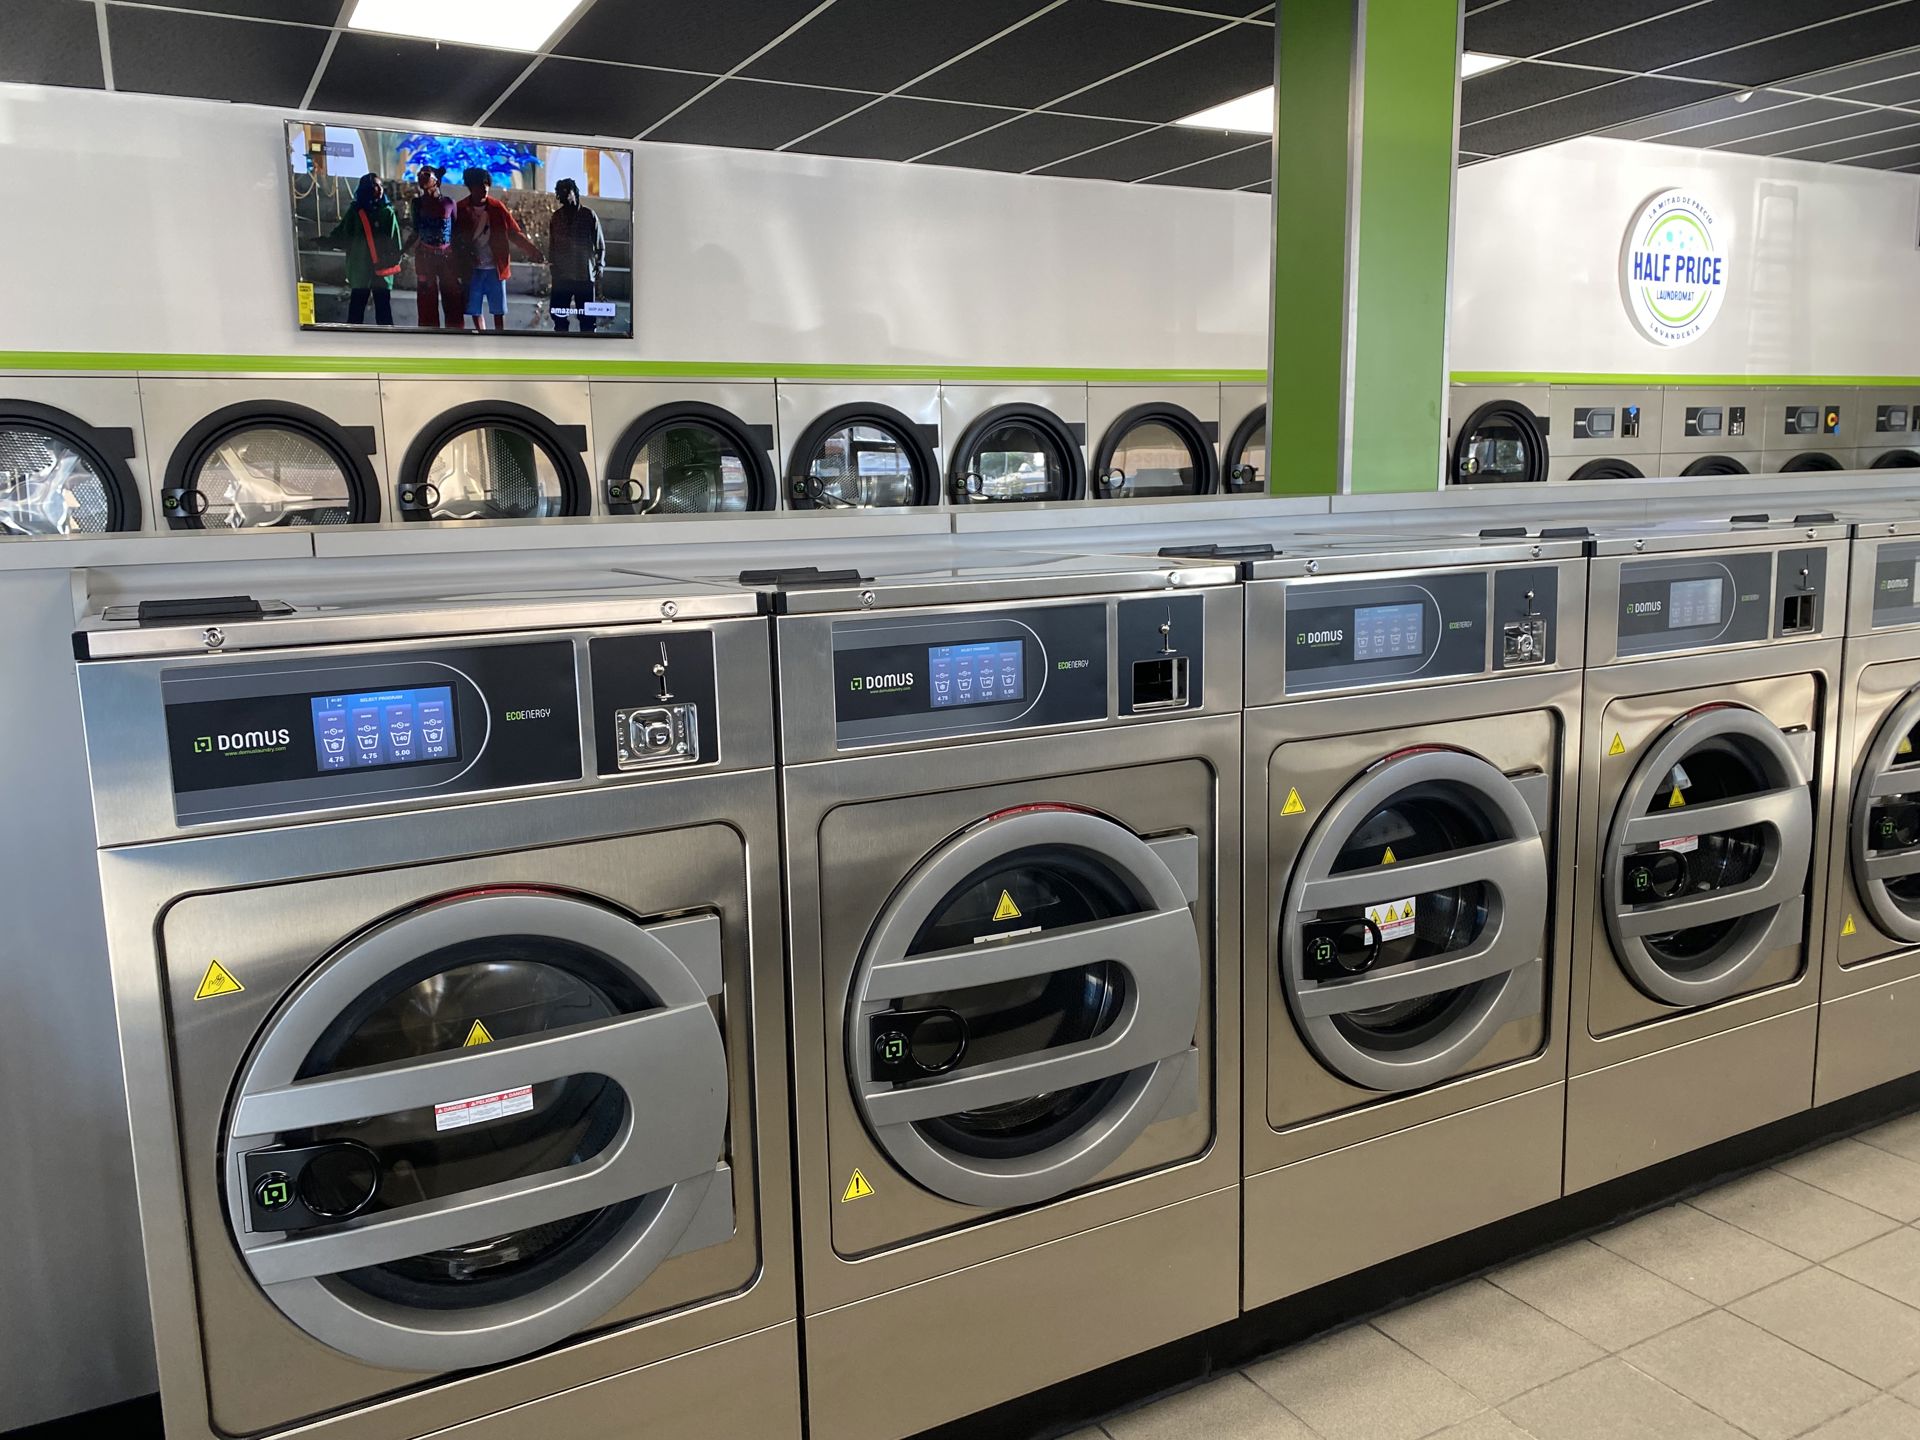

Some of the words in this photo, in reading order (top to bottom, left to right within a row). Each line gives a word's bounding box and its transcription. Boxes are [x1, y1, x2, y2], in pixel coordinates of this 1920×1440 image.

[1658, 196, 1681, 209] MITAD
[1682, 196, 1691, 205] DE
[1692, 200, 1713, 224] PRECIO
[1633, 251, 1671, 282] HALF
[1675, 255, 1722, 285] PRICE
[1656, 289, 1695, 302] LAUNDROMAT
[550, 307, 578, 315] amazon
[1650, 322, 1700, 340] LAVANDERIA
[1635, 600, 1662, 613] DOMUS
[1308, 629, 1343, 644] DOMUS
[866, 672, 914, 689] DOMUS
[506, 708, 551, 721] ECOENERGY
[217, 728, 290, 751] DOMUS
[224, 746, 287, 757] www.domuslaundry.com
[328, 756, 345, 764] 4.75
[362, 752, 378, 760] 4.75
[395, 749, 410, 757] 5.00
